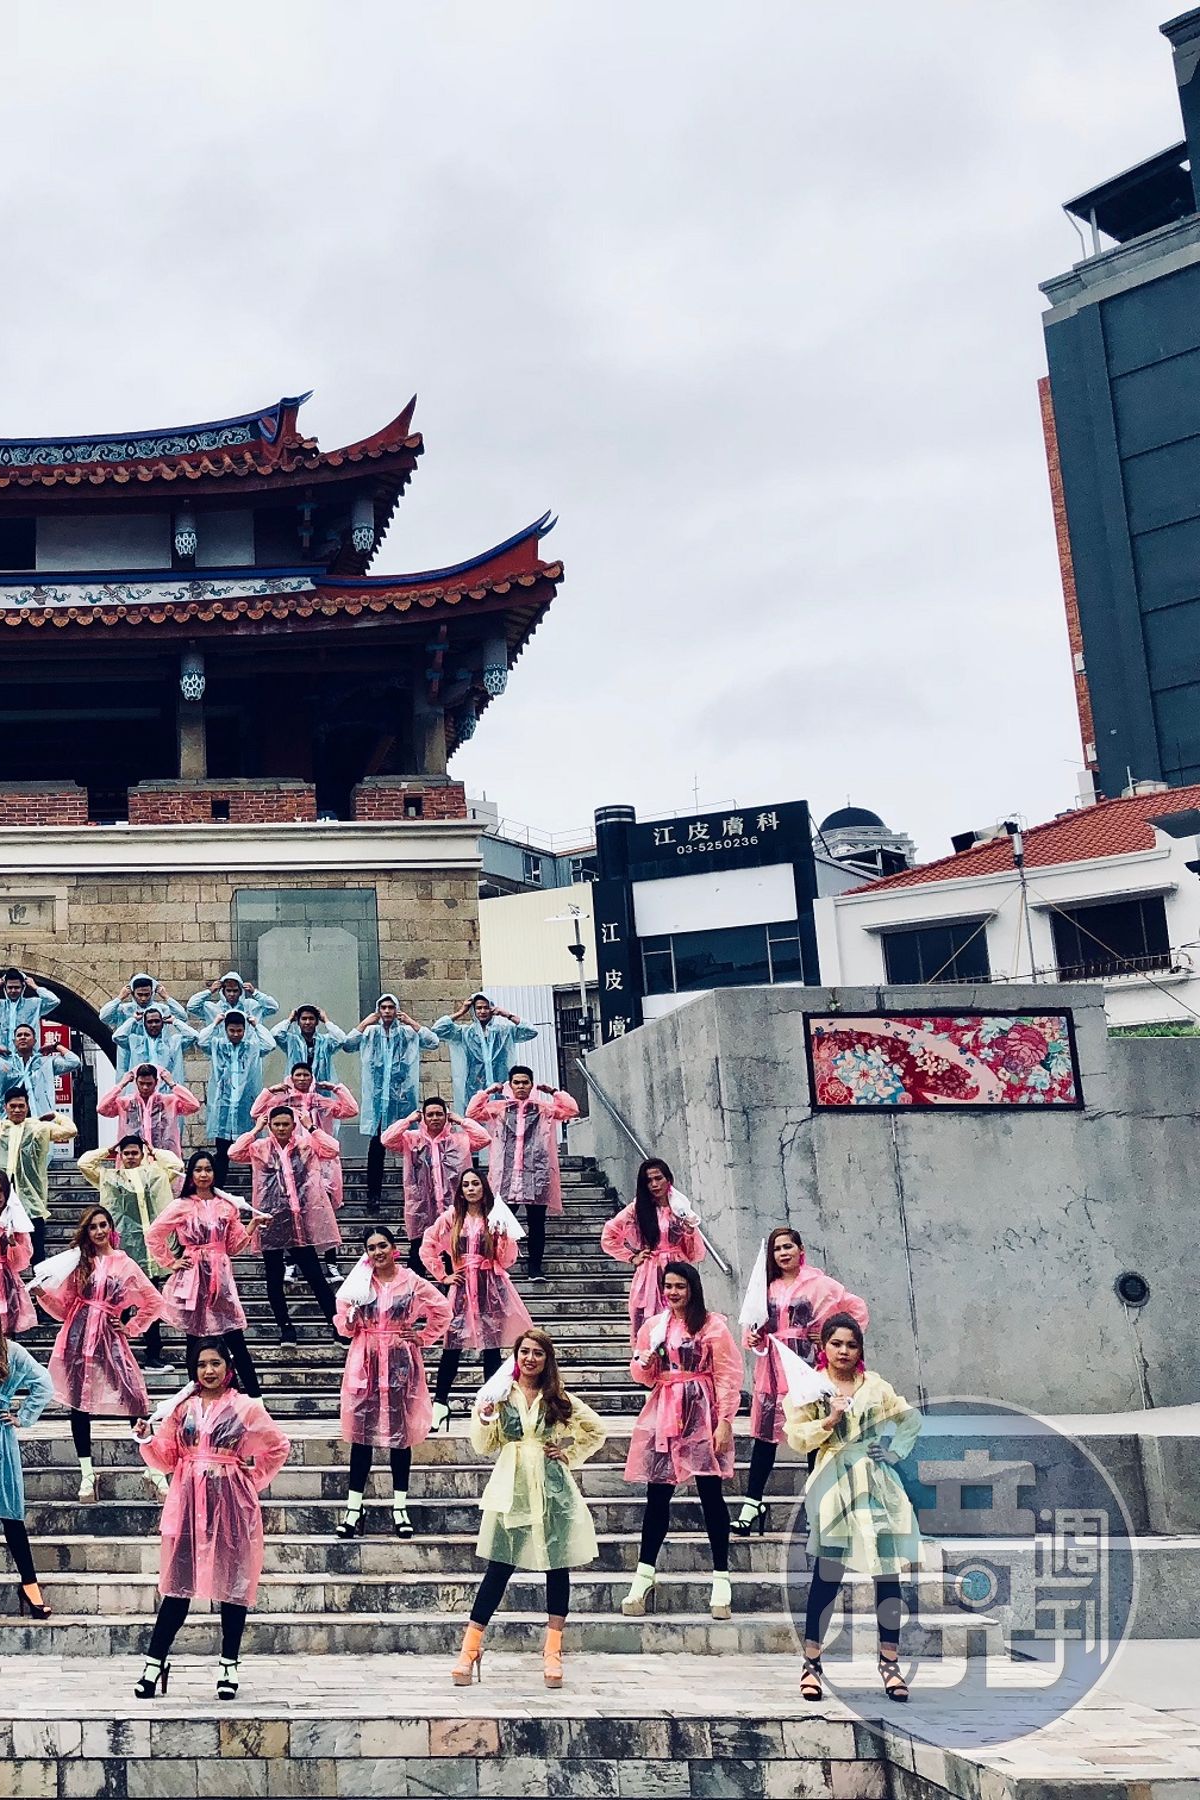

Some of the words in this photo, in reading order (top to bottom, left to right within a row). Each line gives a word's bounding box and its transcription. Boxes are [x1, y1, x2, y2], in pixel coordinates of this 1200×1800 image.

[653, 811, 780, 846] 江皮膚科
[676, 836, 759, 855] 03-5250236
